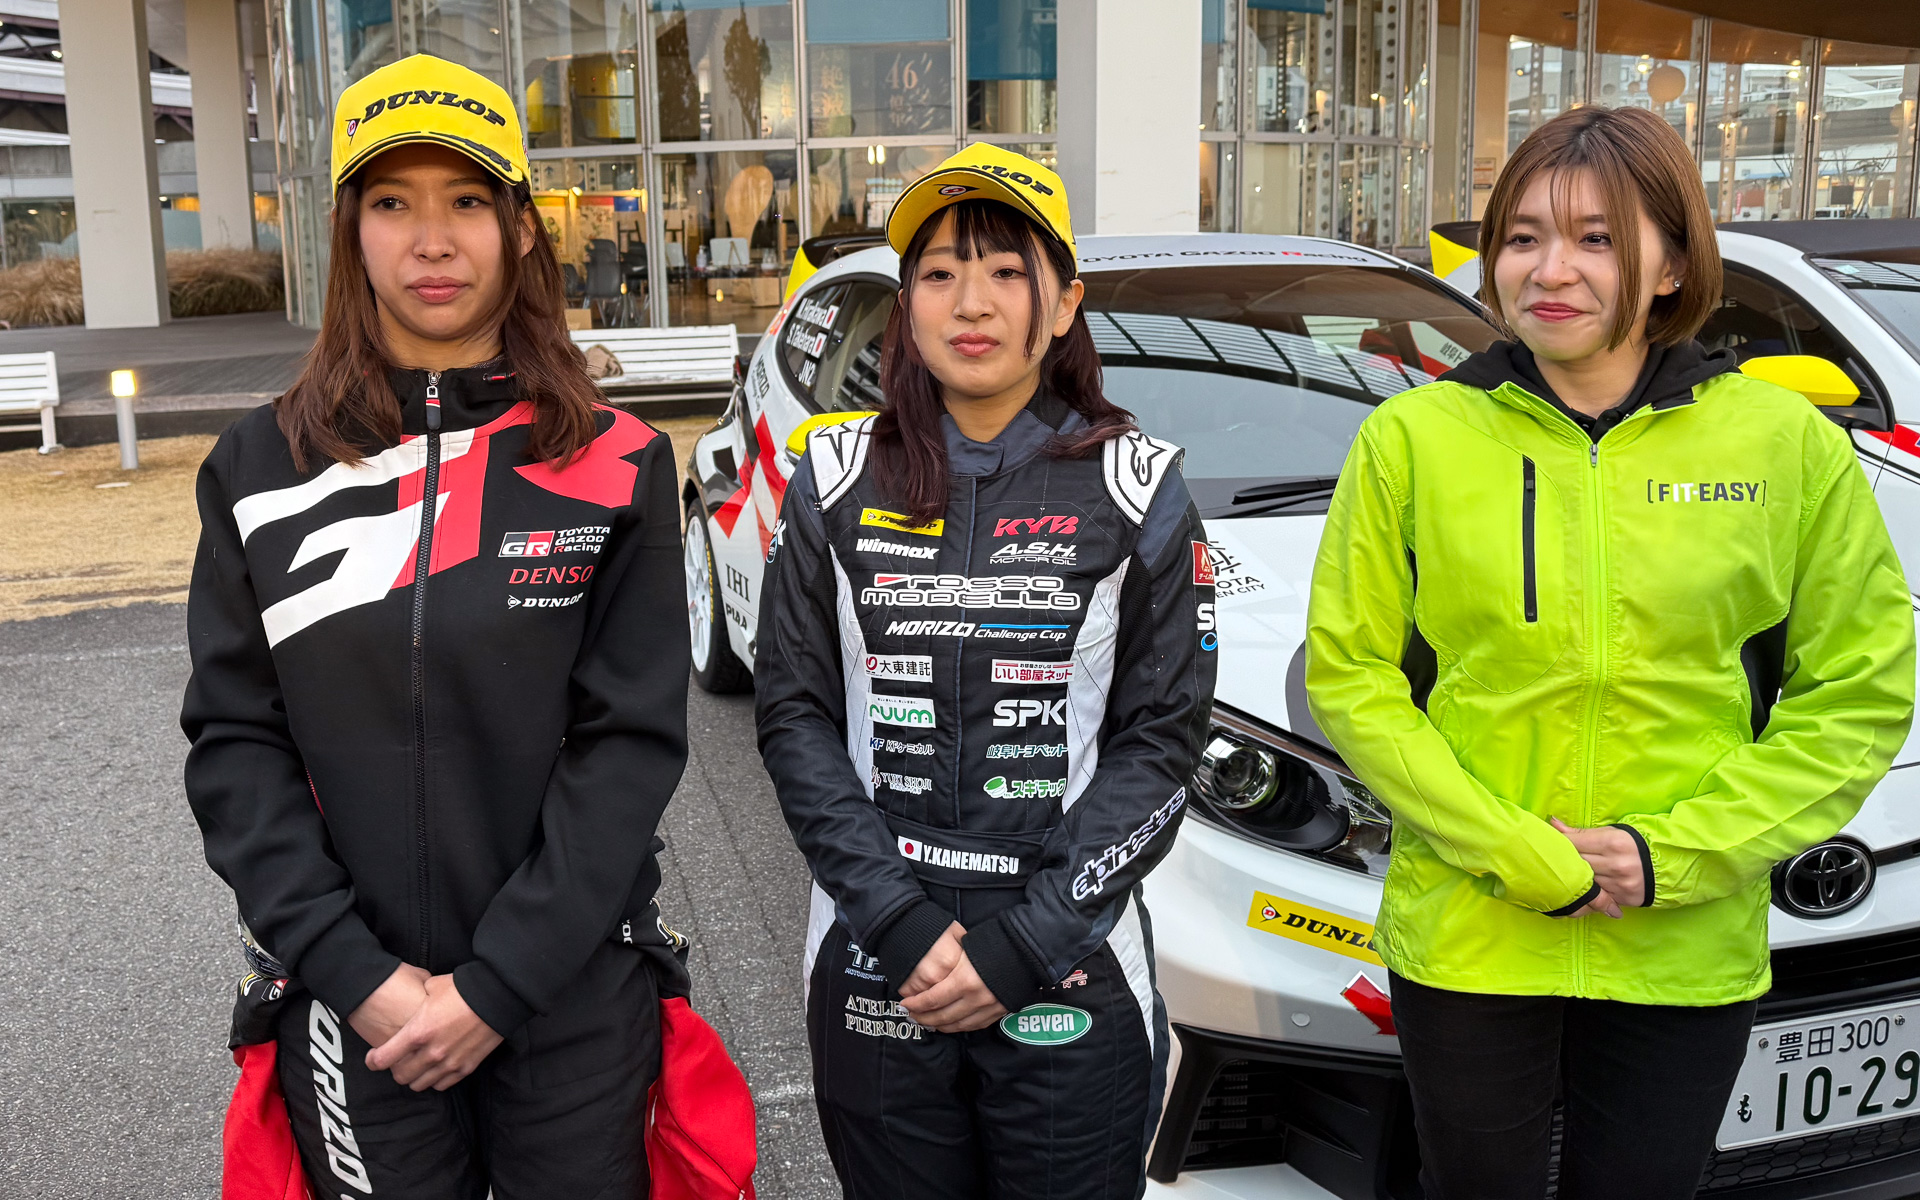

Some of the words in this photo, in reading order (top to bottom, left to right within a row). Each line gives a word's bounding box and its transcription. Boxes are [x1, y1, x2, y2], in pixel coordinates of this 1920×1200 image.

[361, 90, 506, 128] DUNLOP
[1281, 250, 1368, 262] Racing
[557, 526, 611, 538] TOYOTA
[993, 516, 1079, 537] KYB
[501, 542, 550, 555] GR
[553, 543, 602, 554] Racing
[554, 535, 605, 546] GAZOO
[991, 542, 1077, 557] A.S.H.
[989, 556, 1050, 565] MOTOR
[508, 565, 594, 584] DENSO
[726, 564, 751, 603] IHI
[1237, 583, 1265, 594] CITY
[521, 592, 584, 608] DUNLOP
[885, 620, 976, 638] MORIZO
[974, 628, 1037, 642] Challenge
[1038, 630, 1067, 641] Cup
[879, 659, 931, 676] 大東建託
[995, 668, 1072, 681] いい部屋ネット
[993, 699, 1067, 727] SPK
[869, 737, 885, 751] KF
[986, 744, 1069, 759] 岐阜トヨペット
[923, 844, 1019, 875] Y.KANEMATSU
[845, 1013, 924, 1040] PIERROT
[1018, 1013, 1075, 1032] seven
[1775, 1026, 1834, 1064] 豊田
[1838, 1016, 1890, 1052] 300
[1737, 1094, 1752, 1123] も
[1775, 1050, 1920, 1132] 10-29
